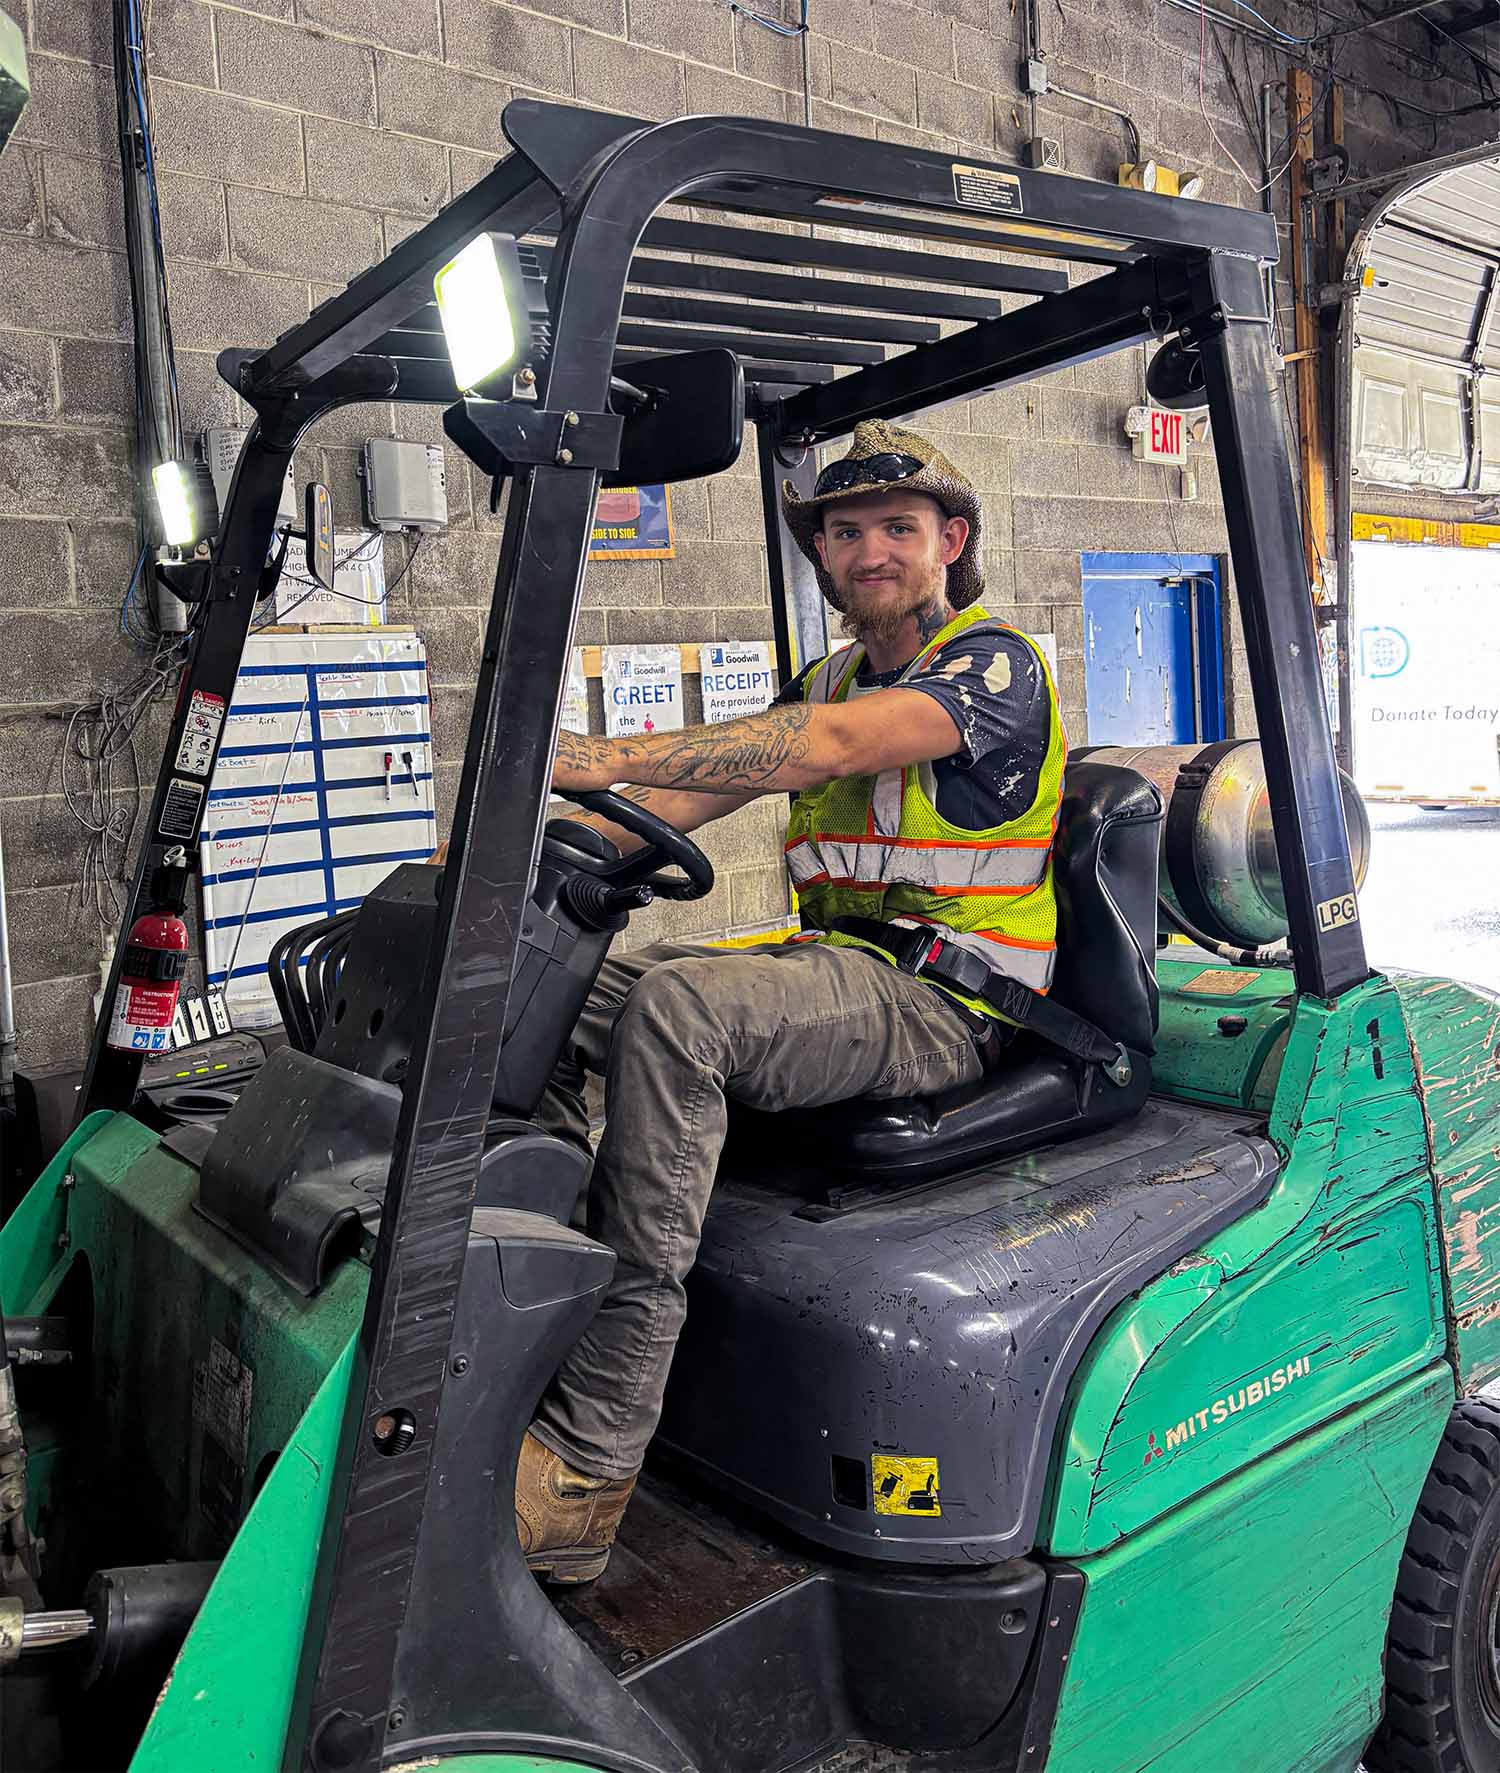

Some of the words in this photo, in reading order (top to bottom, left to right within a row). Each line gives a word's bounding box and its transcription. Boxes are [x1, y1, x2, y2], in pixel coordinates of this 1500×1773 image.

[1152, 412, 1181, 455] EXIT
[592, 528, 607, 539] SIDE
[608, 528, 618, 539] TO
[619, 528, 638, 539] SIDE.
[726, 653, 760, 663] Goodwill
[634, 666, 666, 675] Goodwill
[704, 672, 769, 692] RECEIPT
[613, 684, 675, 705] GREET
[710, 699, 726, 708] Are
[728, 694, 766, 709] provided
[619, 716, 635, 726] the
[1371, 707, 1437, 722] Donate
[1442, 704, 1499, 724] Today
[1319, 898, 1356, 928] LPG
[213, 1001, 226, 1030] THU
[1366, 1017, 1384, 1080] 1
[1165, 1356, 1312, 1451] MITSUBISHI
